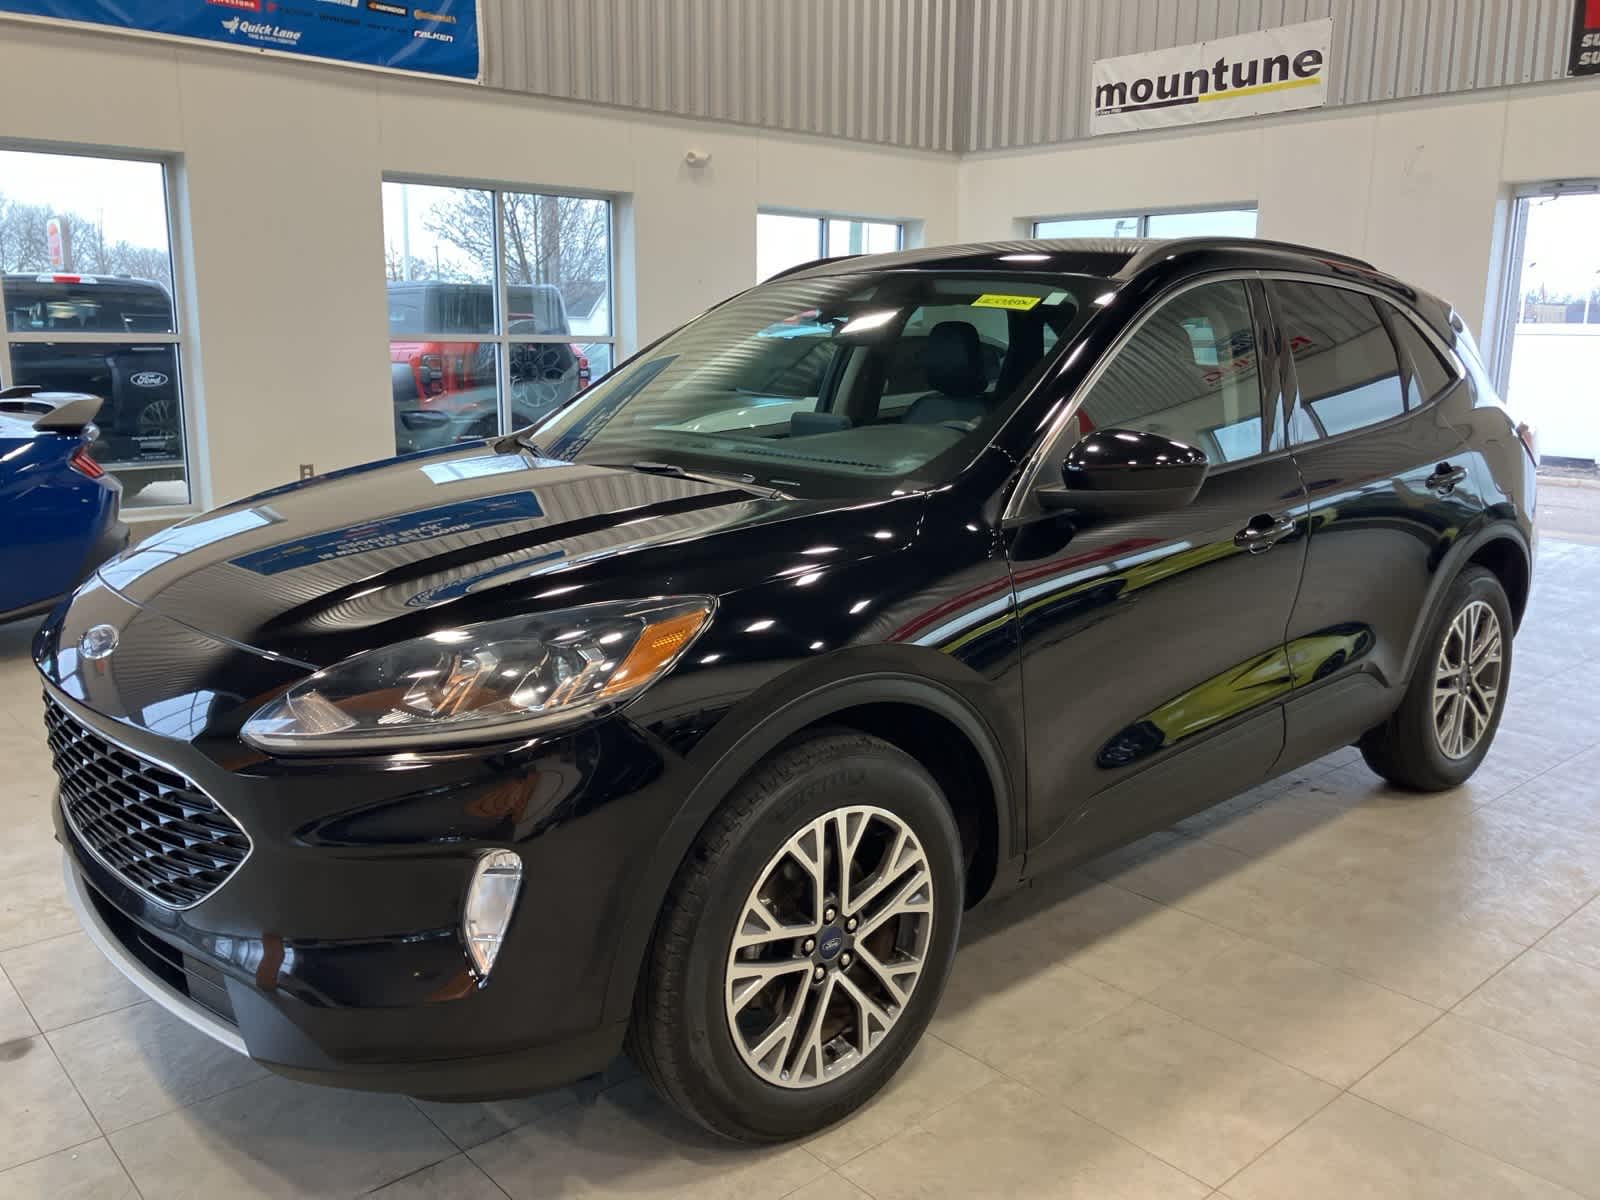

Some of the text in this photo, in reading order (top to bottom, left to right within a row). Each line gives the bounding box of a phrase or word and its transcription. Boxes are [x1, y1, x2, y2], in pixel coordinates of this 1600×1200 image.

[240, 21, 272, 35] Quick
[272, 26, 302, 40] Lane
[1095, 49, 1323, 109] mountune
[136, 374, 162, 386] Ford
